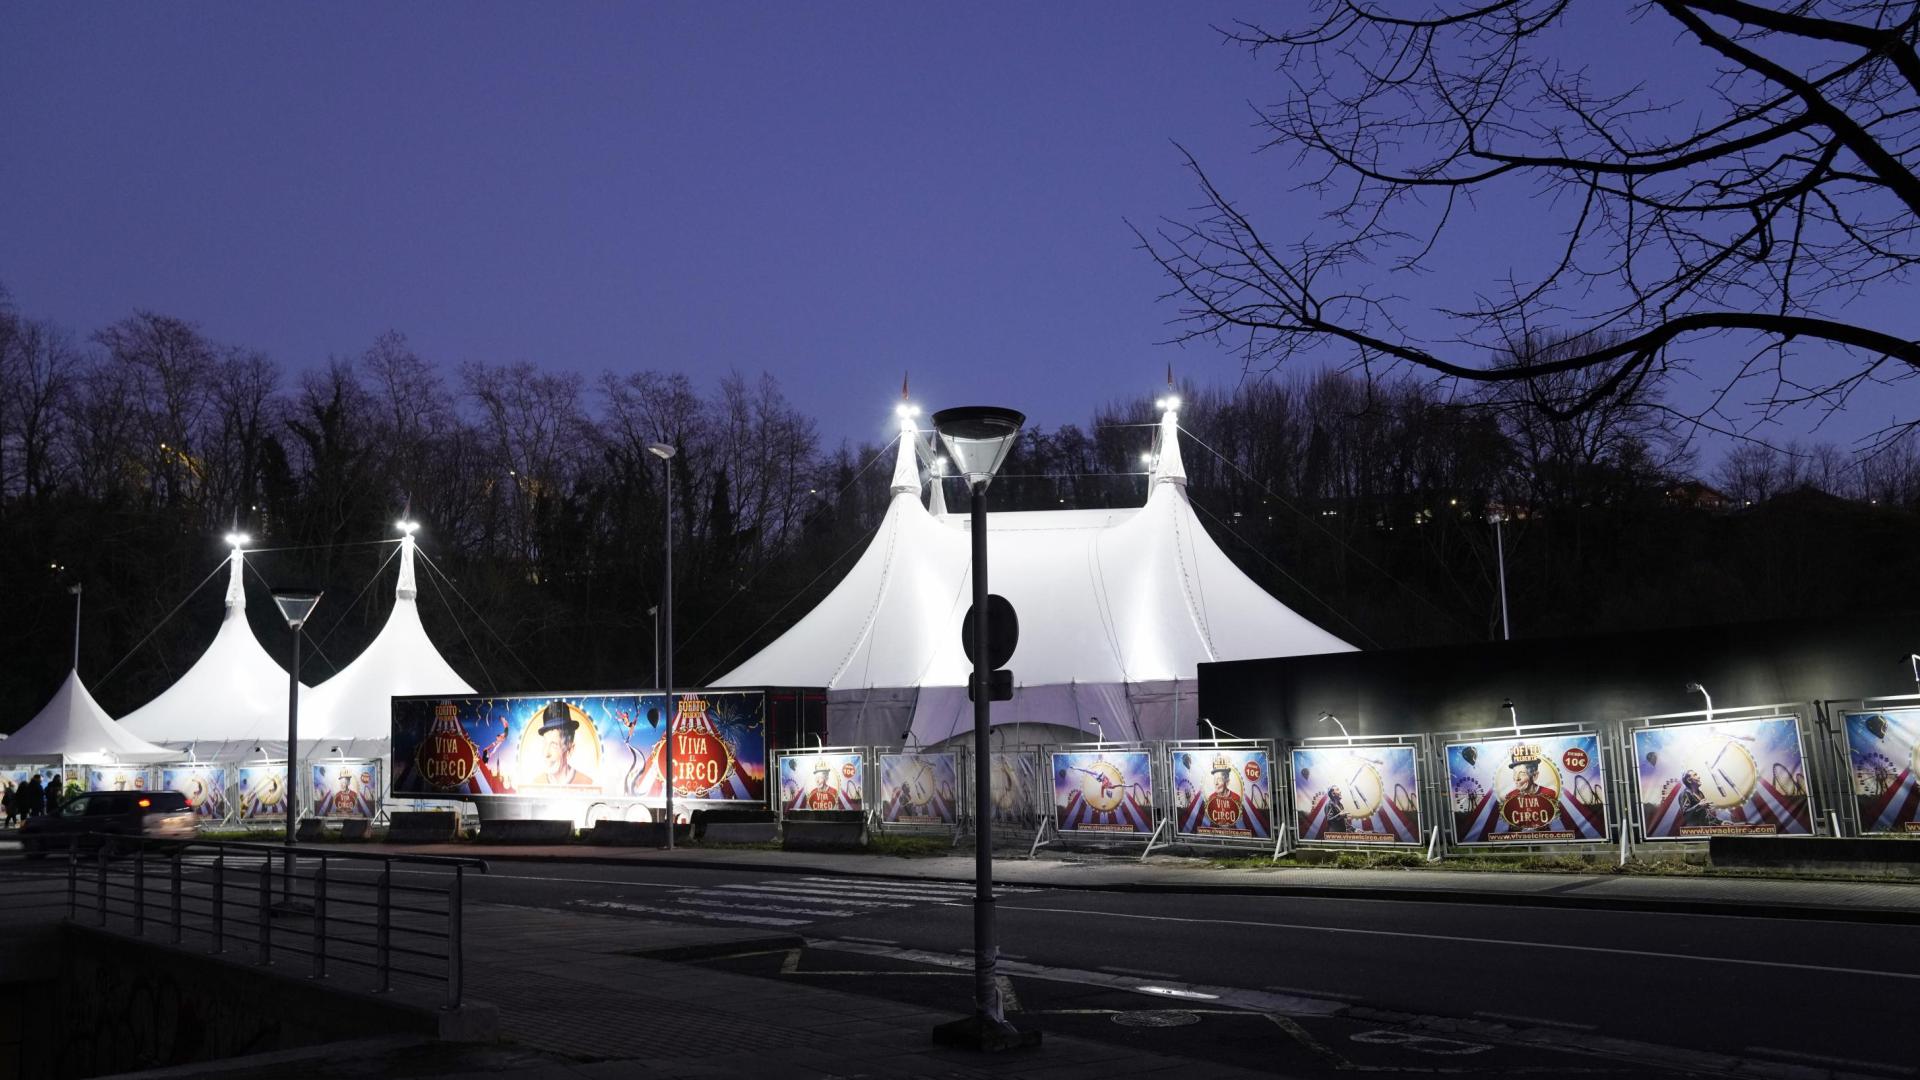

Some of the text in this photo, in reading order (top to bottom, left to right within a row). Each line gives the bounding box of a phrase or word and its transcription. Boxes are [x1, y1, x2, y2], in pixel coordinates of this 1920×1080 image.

[435, 736, 458, 754] VIVA
[678, 736, 707, 755] VIVA
[1565, 758, 1585, 767] 10€
[427, 758, 466, 780] CIRCO
[1246, 768, 1259, 778] 10€
[1216, 798, 1231, 809] VIVA
[1518, 797, 1540, 809] VIVA
[1212, 810, 1236, 822] CIRCO
[1512, 809, 1548, 824] CIRCO
